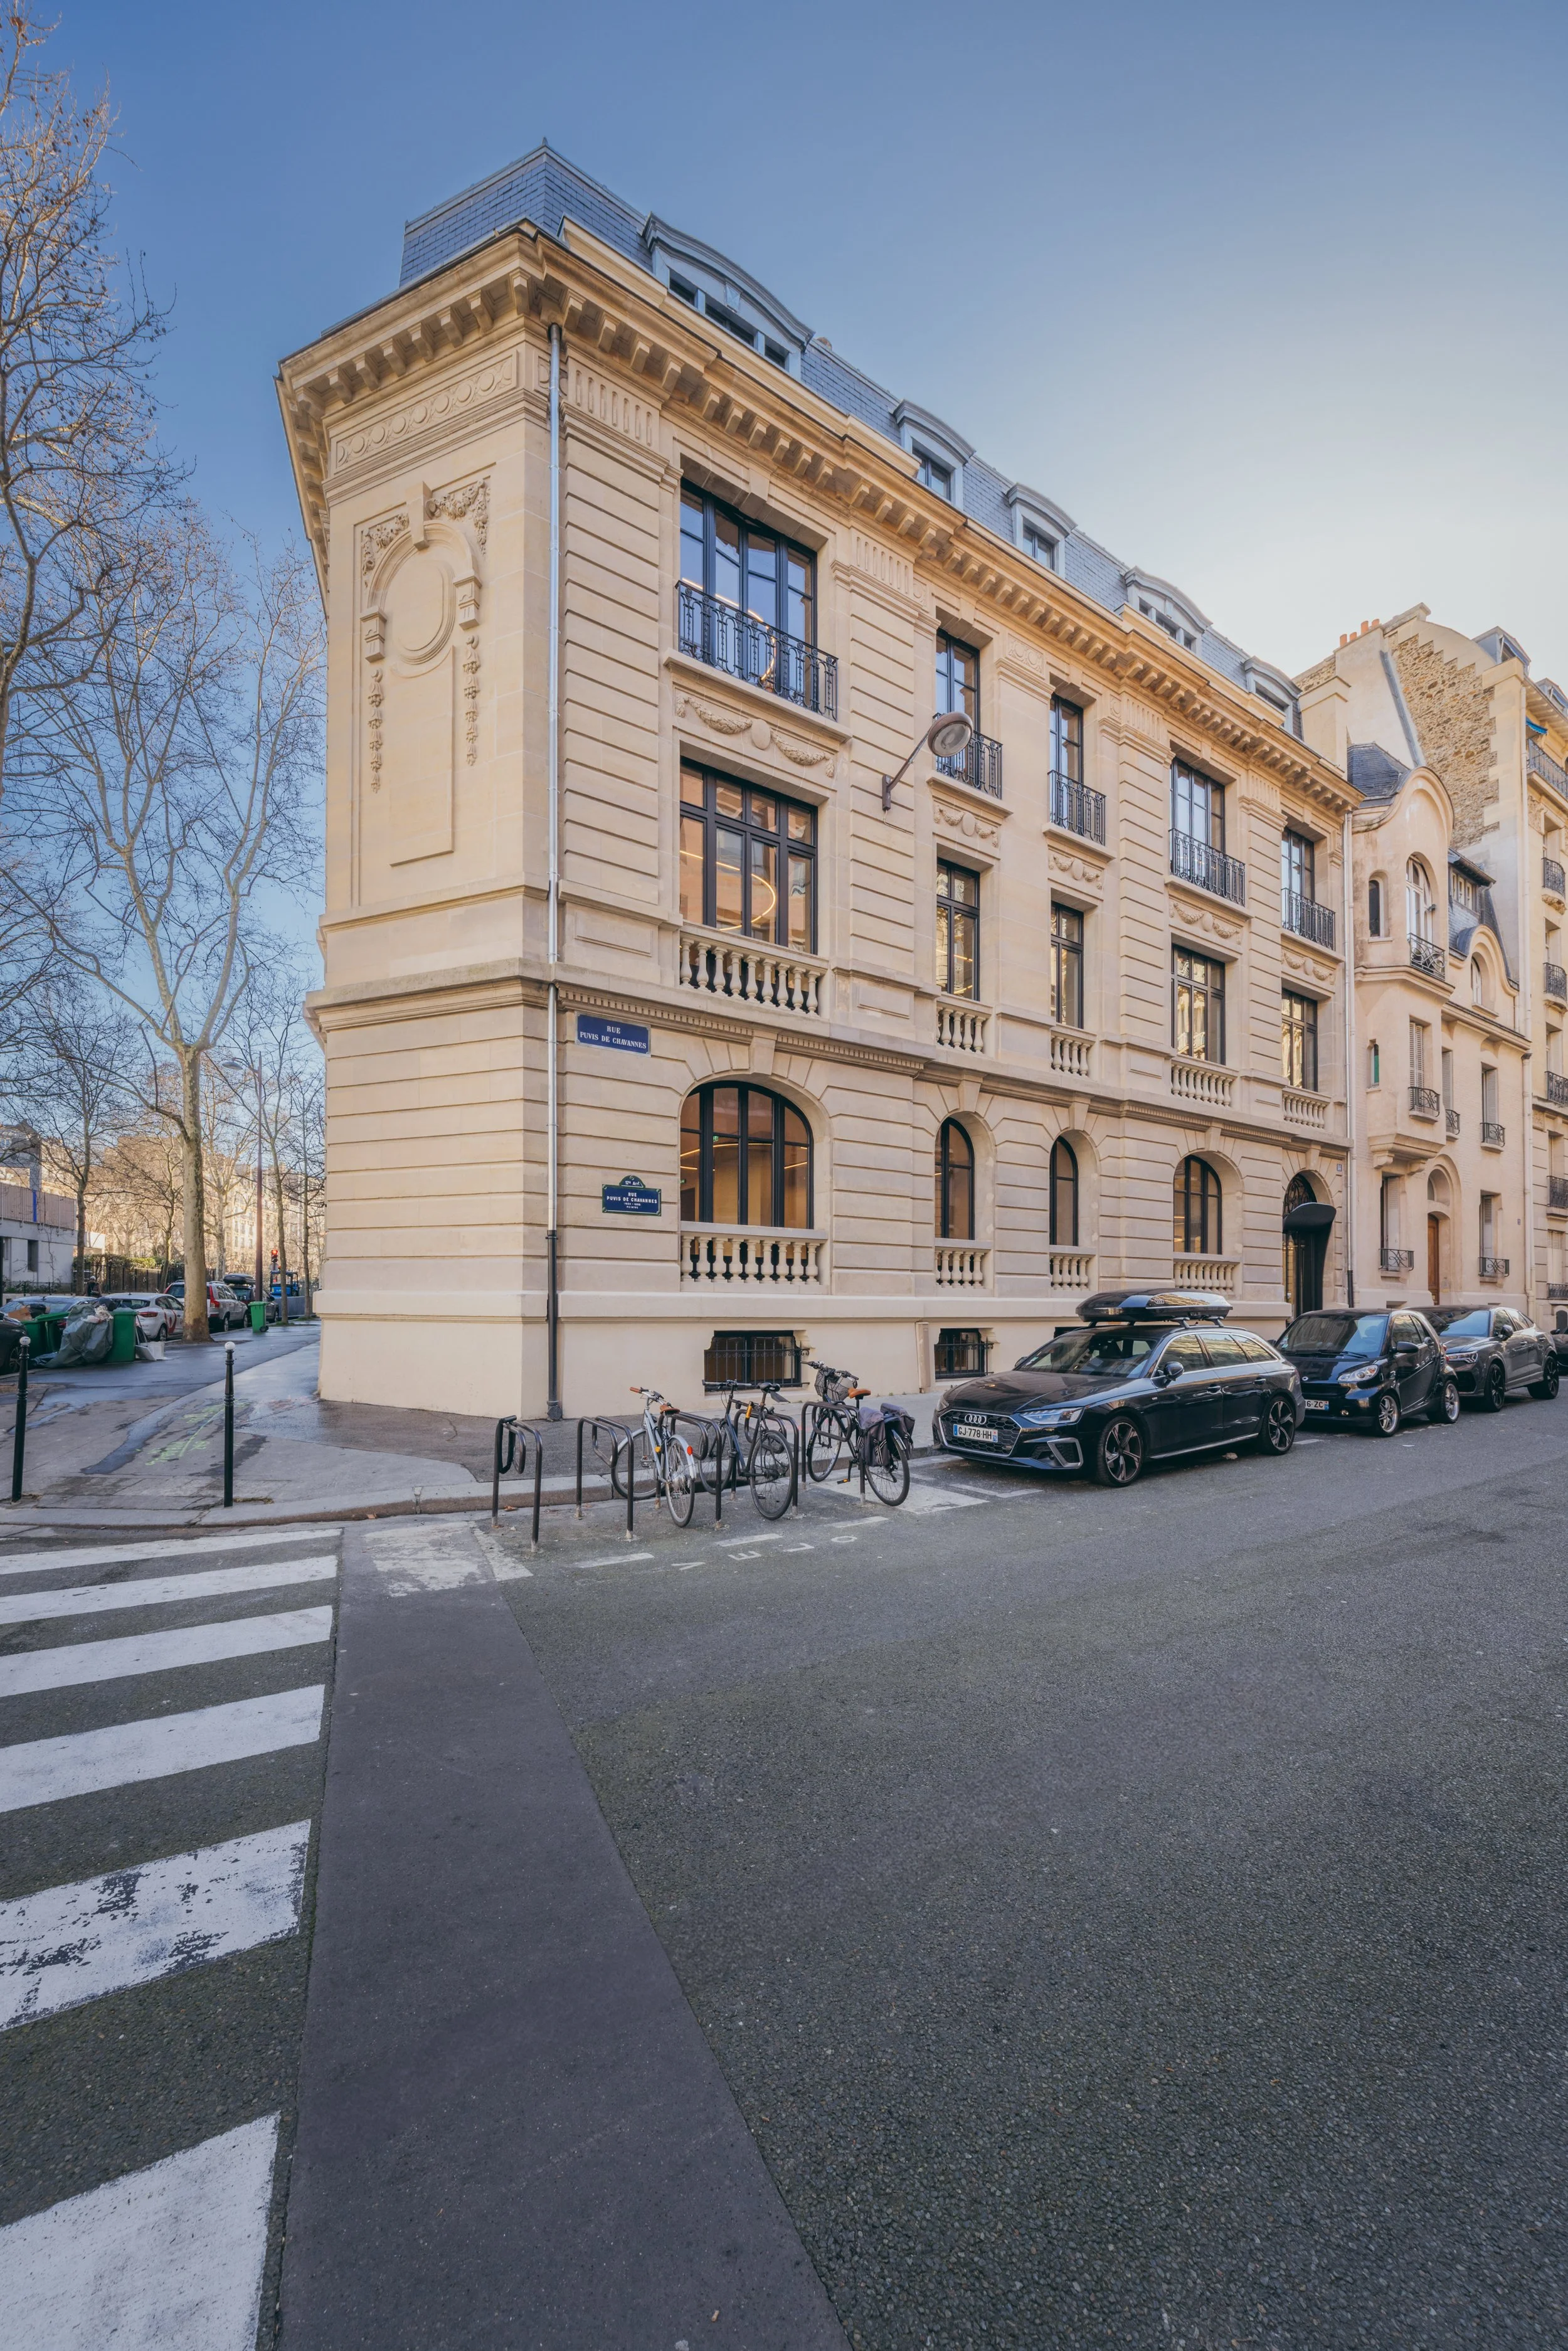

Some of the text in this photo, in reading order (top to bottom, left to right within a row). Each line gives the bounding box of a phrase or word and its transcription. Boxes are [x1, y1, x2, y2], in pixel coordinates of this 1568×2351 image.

[607, 1026, 621, 1034] RUE
[580, 1031, 599, 1041] PUVIS
[612, 1038, 647, 1049] CHAVANNES
[958, 1426, 992, 1440] GJ-778-HH
